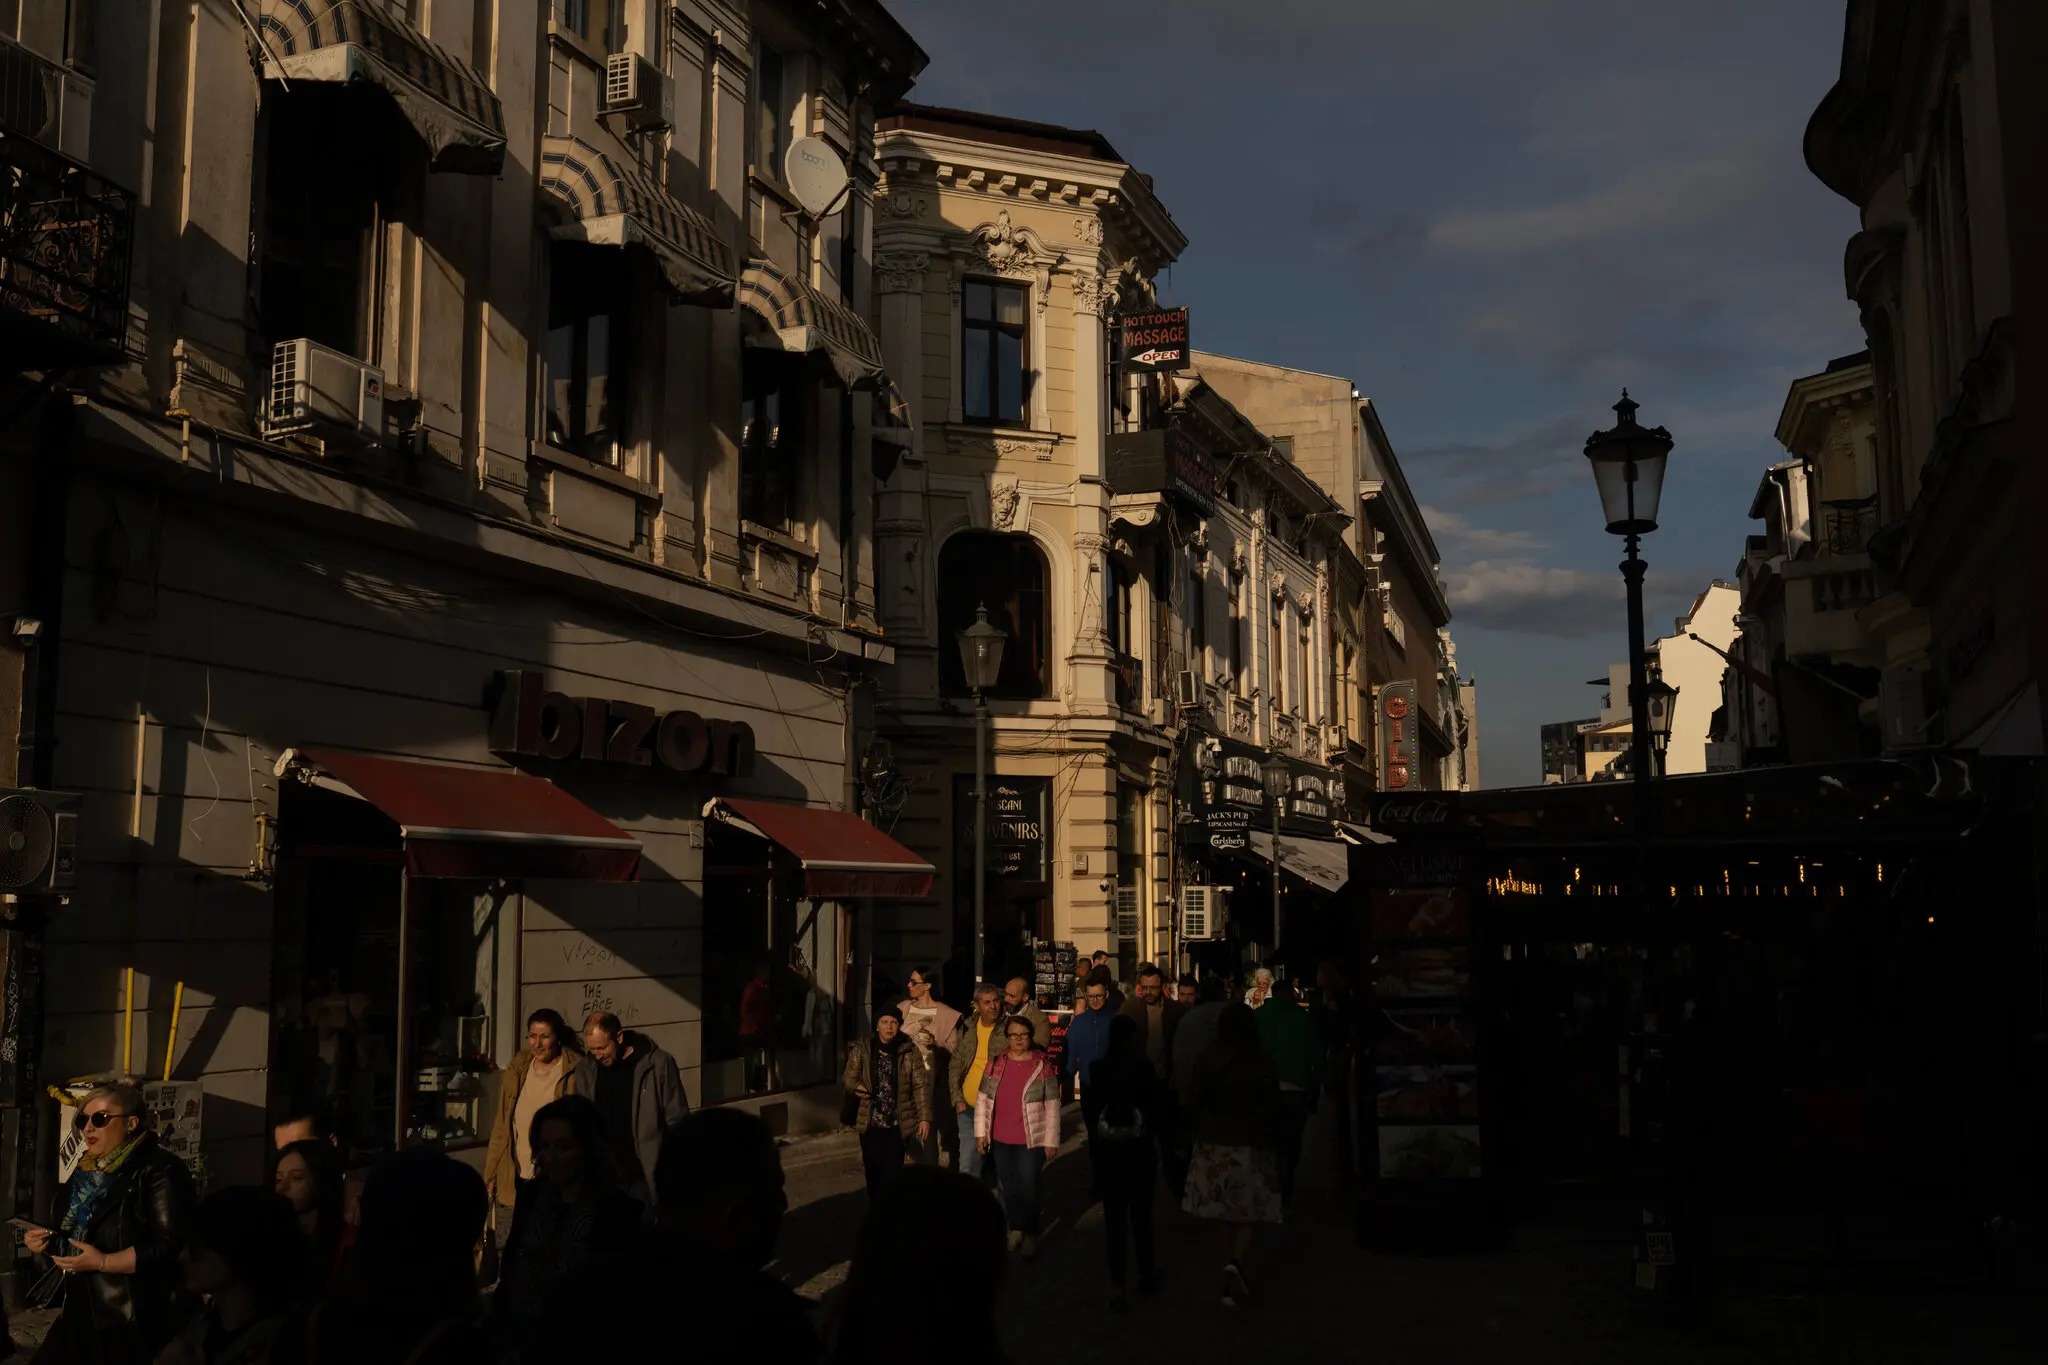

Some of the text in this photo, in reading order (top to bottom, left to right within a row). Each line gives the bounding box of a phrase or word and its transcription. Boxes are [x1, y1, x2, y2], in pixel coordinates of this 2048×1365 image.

[1123, 310, 1185, 327] HOT TOUCH
[1123, 326, 1185, 347] MASSAGE
[1142, 351, 1179, 361] OPEN
[488, 669, 756, 778] bizon
[1385, 695, 1409, 791] GILD
[1206, 811, 1249, 821] JACK'S PUB
[1210, 834, 1245, 848] Carlsberg
[583, 983, 602, 999] THE
